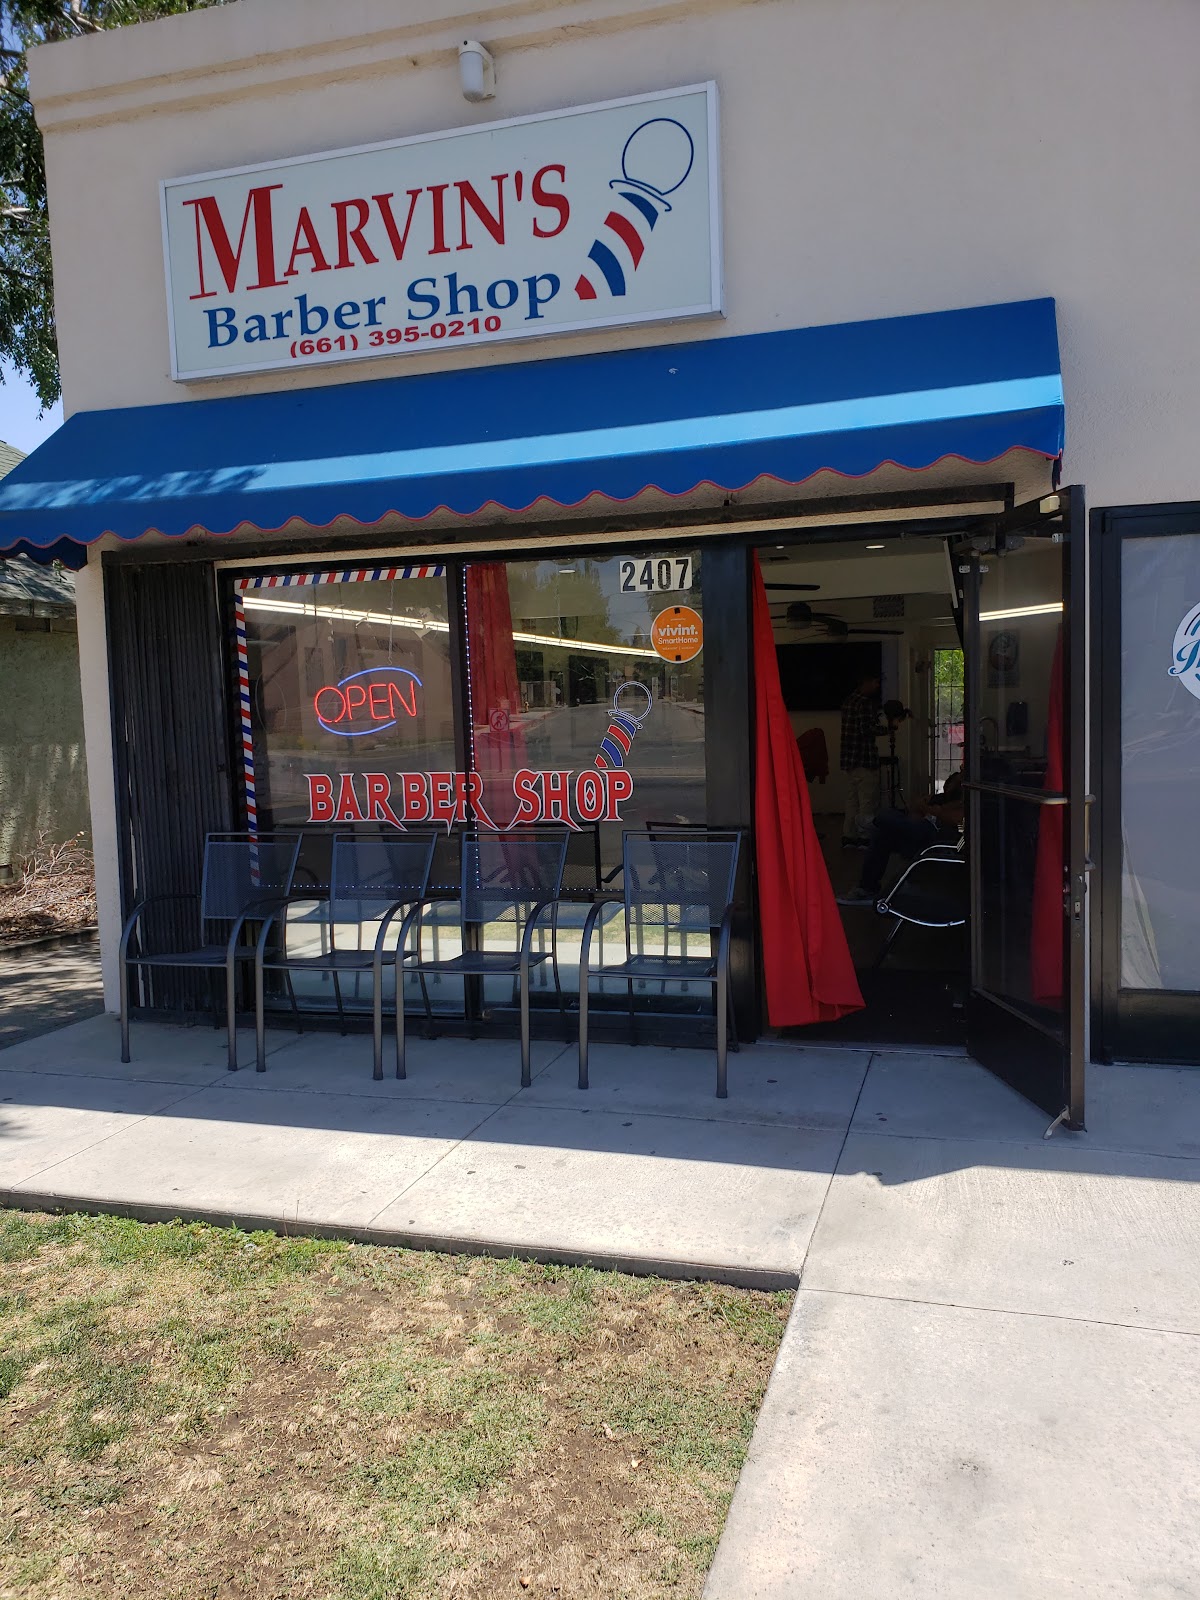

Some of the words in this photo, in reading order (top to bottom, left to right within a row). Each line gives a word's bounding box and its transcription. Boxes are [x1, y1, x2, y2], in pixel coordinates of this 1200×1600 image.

[183, 164, 571, 300] MARVIN'S
[203, 293, 386, 348] Barber
[406, 271, 561, 319] Shop
[290, 334, 359, 358] (661)
[369, 315, 502, 347] 395-0210
[621, 559, 689, 592] 2407
[658, 637, 699, 645] SmartHome
[313, 680, 417, 723] OPEN
[303, 771, 501, 837] BARBER
[502, 768, 634, 832] SHOP
